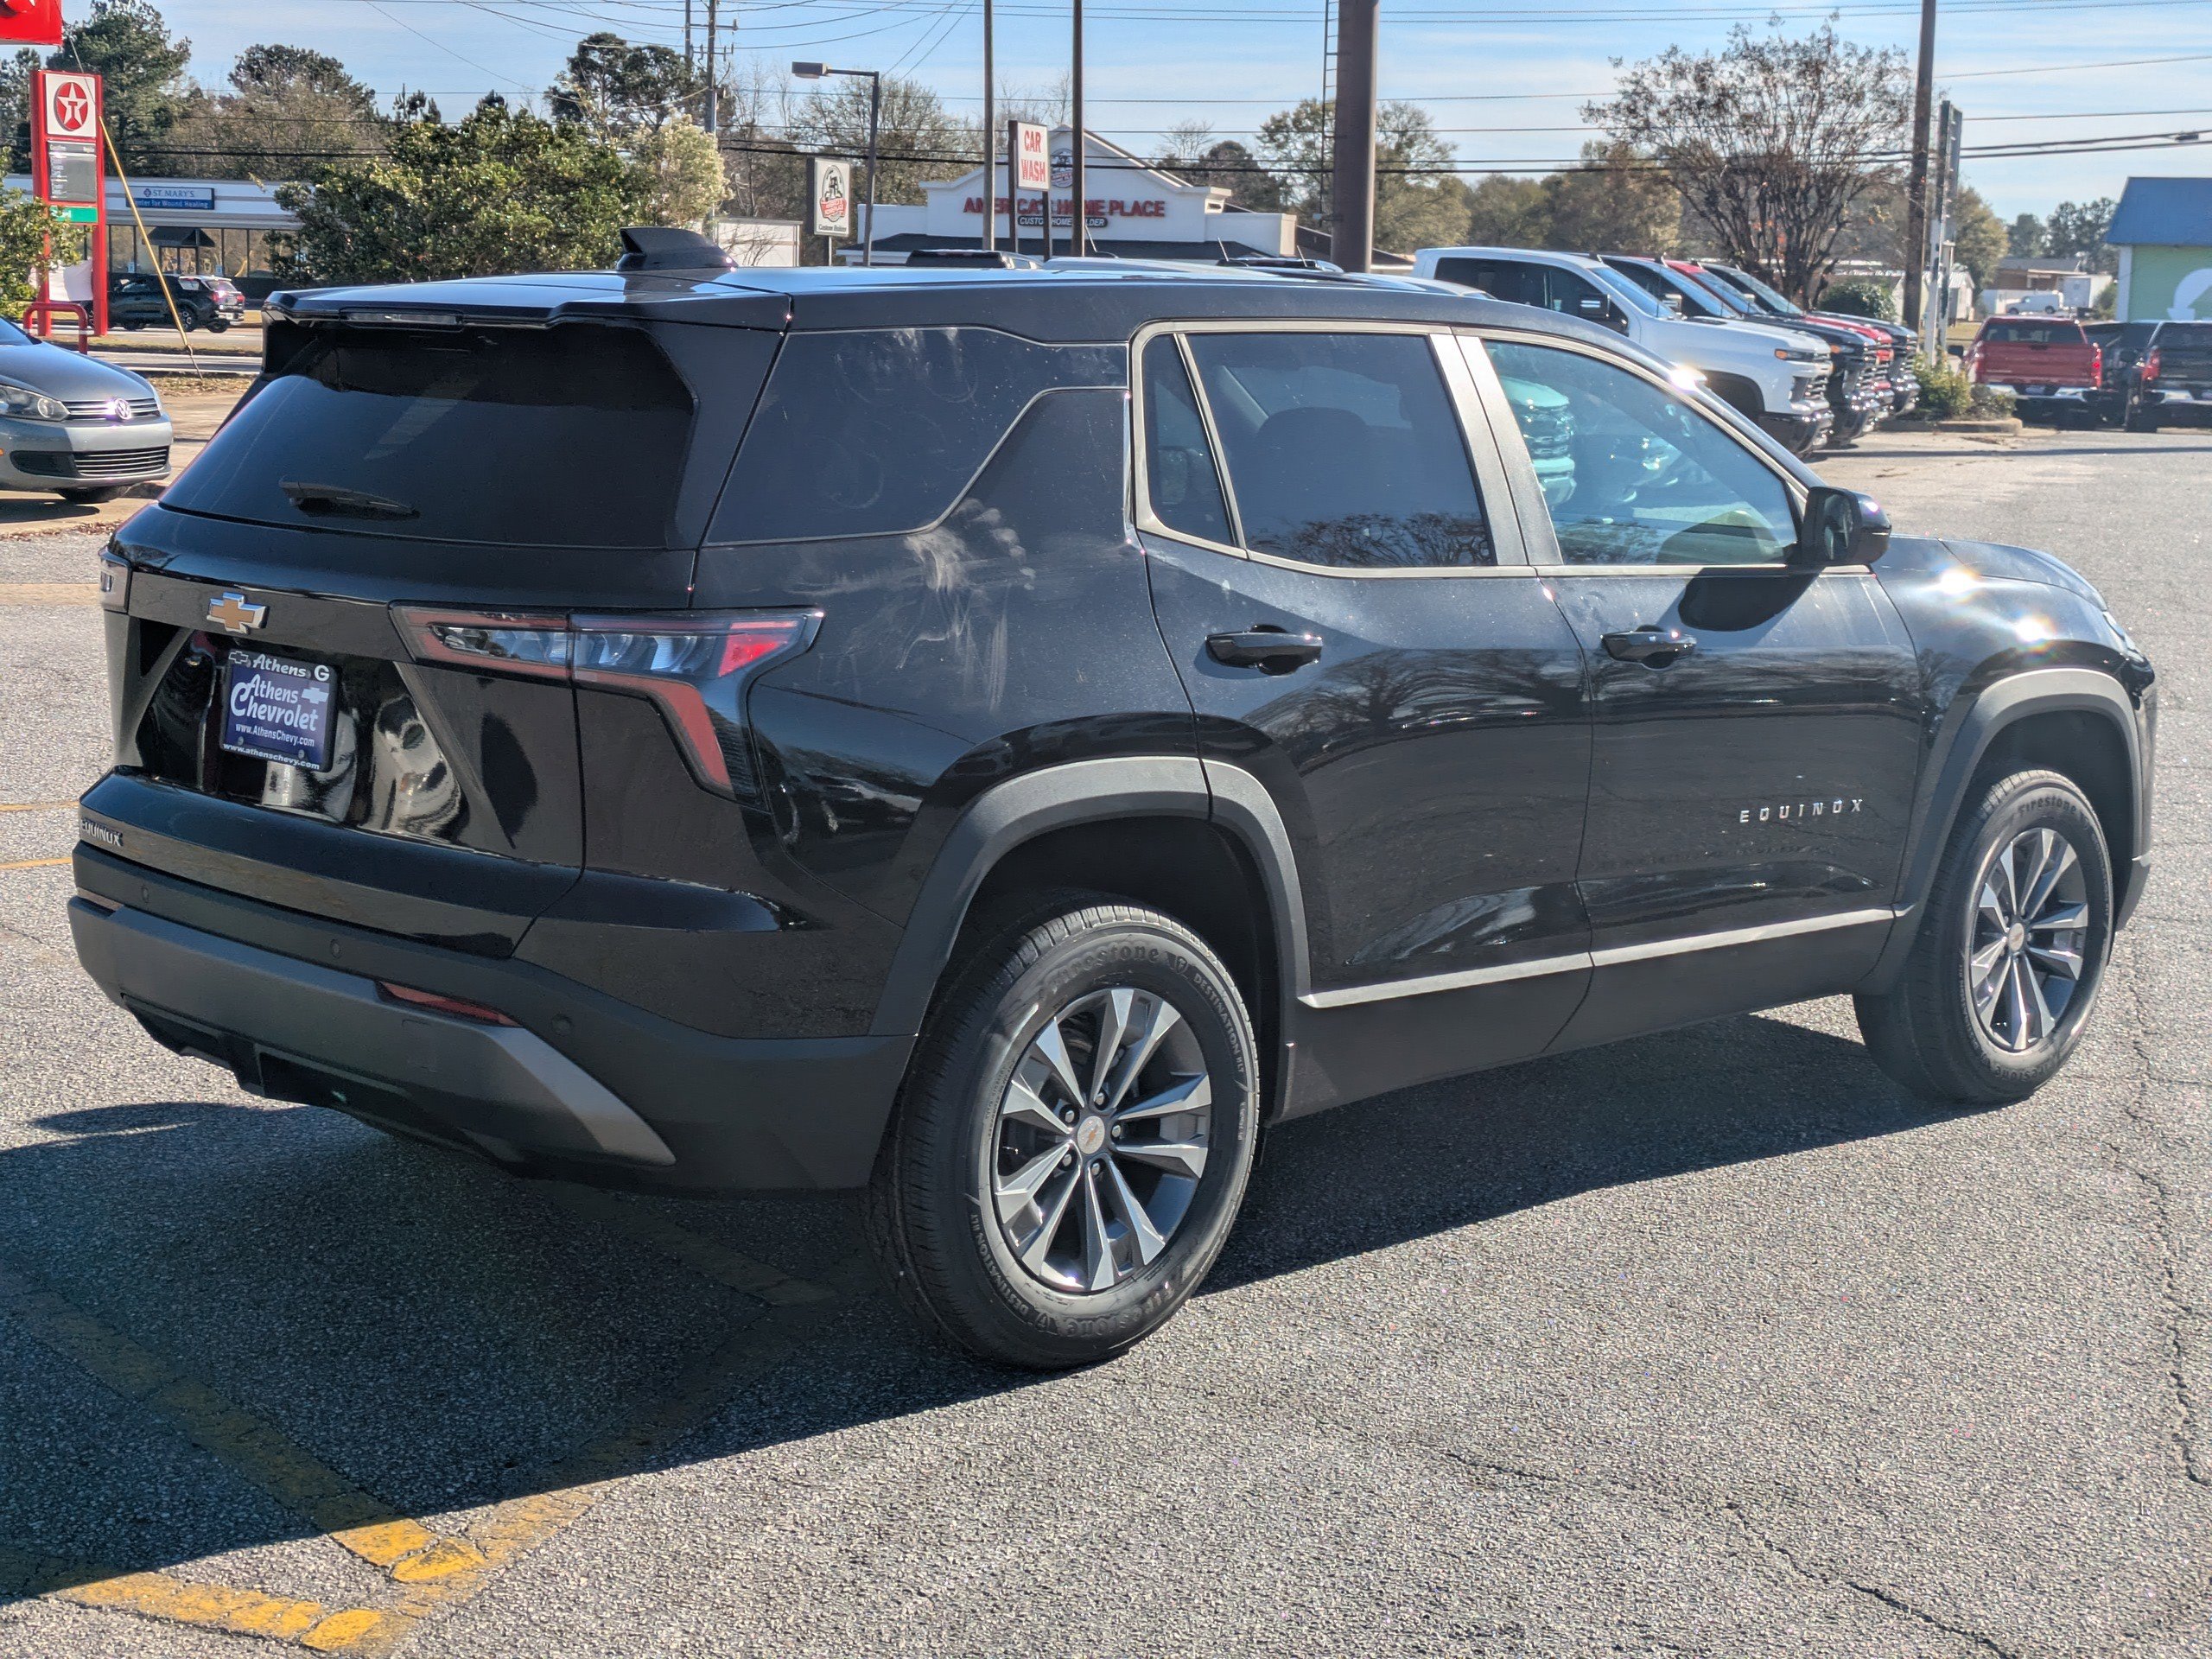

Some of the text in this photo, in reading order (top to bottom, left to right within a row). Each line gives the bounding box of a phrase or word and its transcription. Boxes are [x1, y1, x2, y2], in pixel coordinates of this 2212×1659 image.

[1024, 130, 1042, 154] CAR
[1021, 158, 1046, 183] WASH
[165, 189, 194, 198] MARY'S
[1056, 199, 1106, 216] HME
[1109, 200, 1166, 217] PLACE
[1020, 217, 1045, 226] CUSTO
[1052, 218, 1073, 226] HOME
[252, 653, 330, 682] Athens G
[240, 673, 299, 704] Athens
[230, 682, 319, 732] Chevrolet
[235, 722, 315, 747] www.AthensChevy.com
[223, 742, 320, 771] www.athenschevy.com
[1739, 798, 1863, 823] EQUINOX
[79, 817, 122, 847] EQUINOX
[1193, 972, 1241, 1056] DESTINATION
